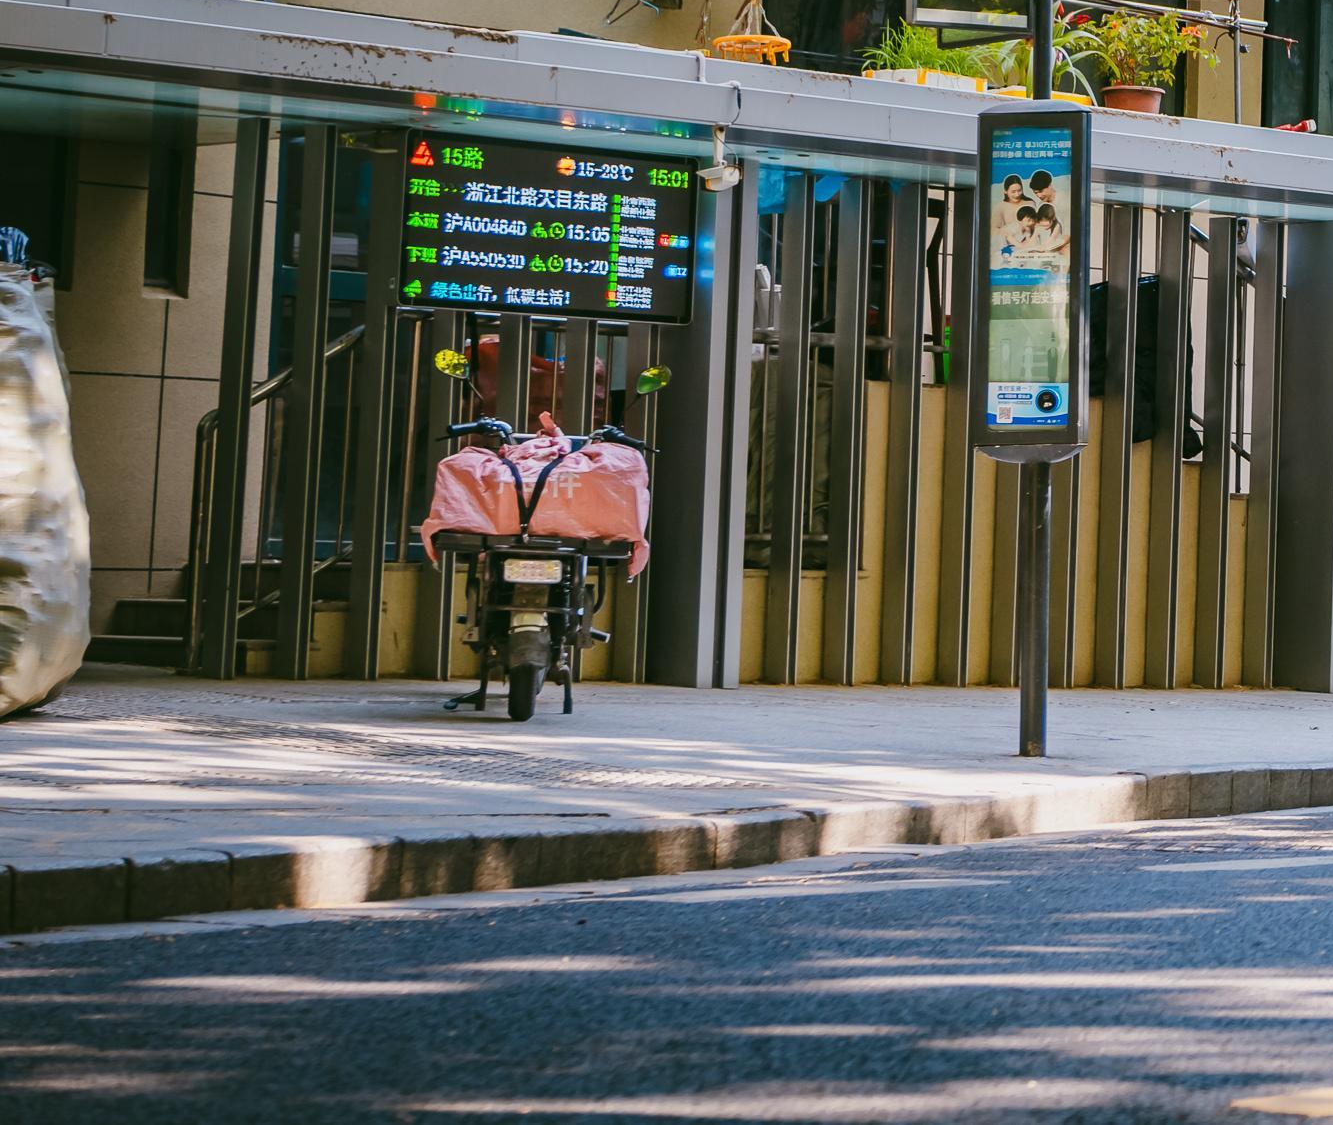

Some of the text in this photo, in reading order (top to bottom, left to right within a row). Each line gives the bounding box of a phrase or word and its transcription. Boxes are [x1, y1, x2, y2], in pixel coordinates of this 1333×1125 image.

[441, 146, 485, 170] 15路
[648, 168, 689, 189] 15:01
[464, 182, 609, 213] 浙江北路天目东路
[443, 212, 528, 237] 沪A00484D
[567, 224, 611, 243] 15:05
[441, 246, 527, 270] 沪A55053D
[564, 257, 609, 276] 15:20
